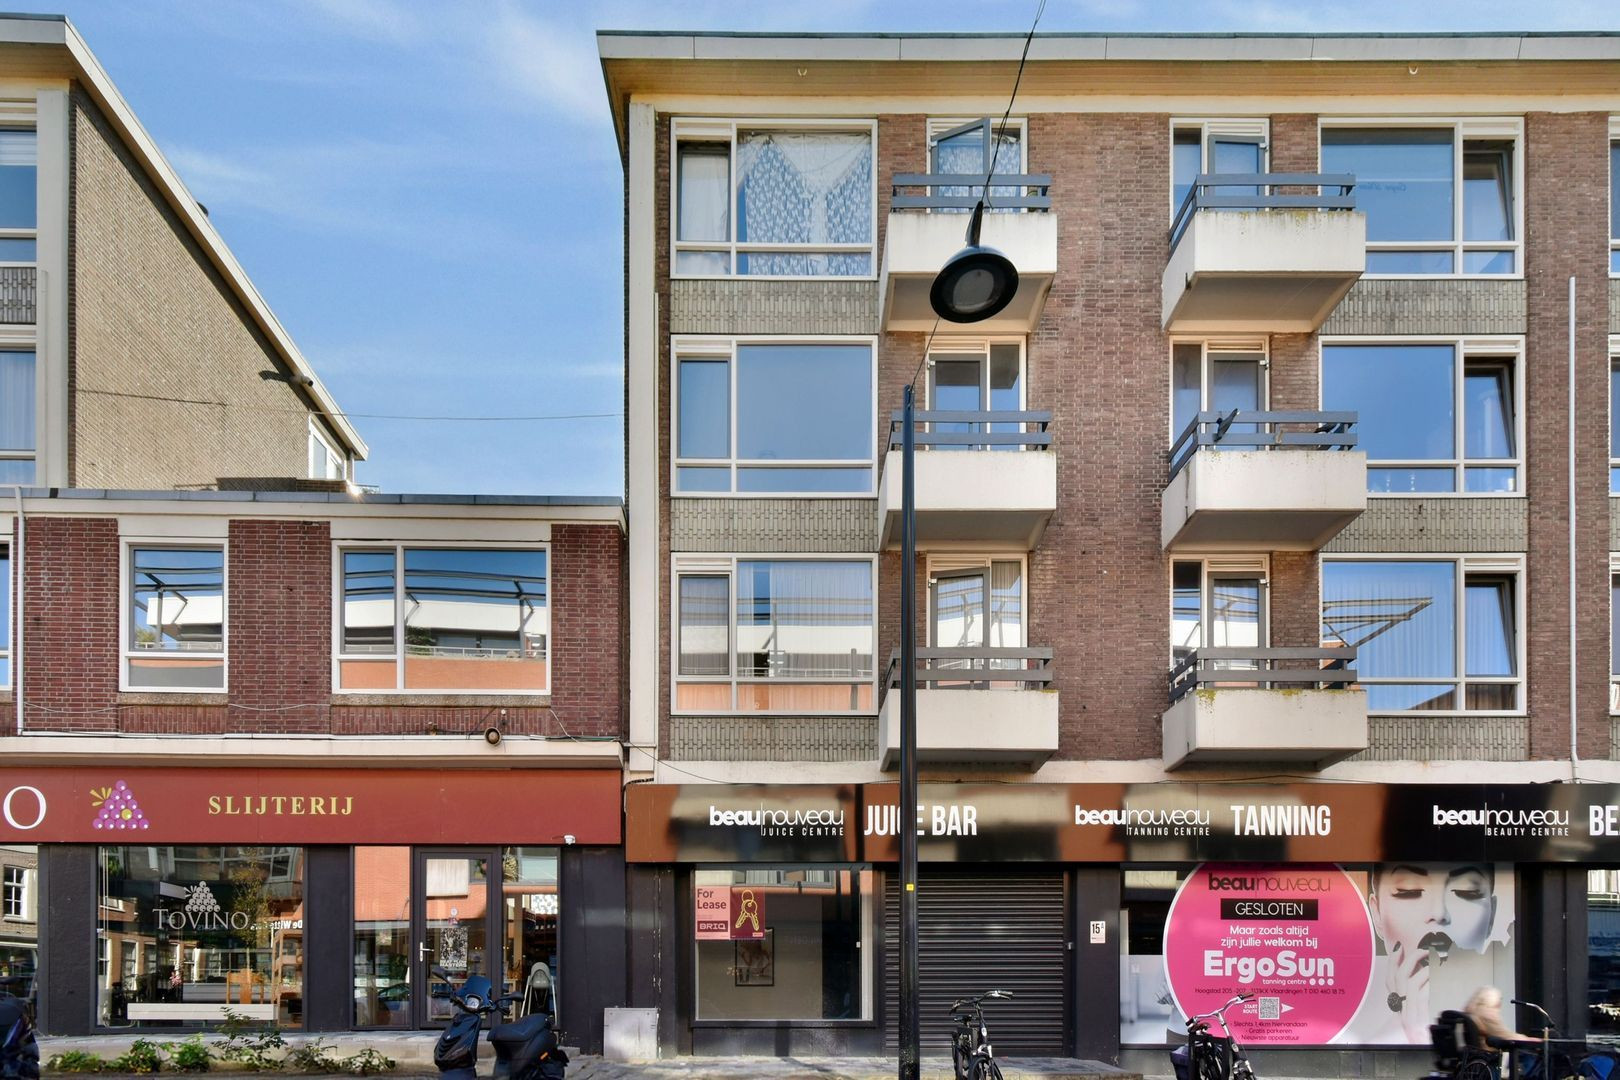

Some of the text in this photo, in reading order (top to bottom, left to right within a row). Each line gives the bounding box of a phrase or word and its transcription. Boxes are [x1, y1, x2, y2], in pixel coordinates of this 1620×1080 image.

[3, 785, 47, 830] O
[208, 795, 355, 816] SLIJTERIJ
[863, 804, 978, 836] JUIE BAR
[1229, 804, 1331, 836] TANNING
[763, 827, 844, 837] JUICE CENTRE
[1128, 827, 1210, 836] TANNING CENTRE
[1487, 827, 1569, 837] BEAUTY CENTRE
[697, 888, 714, 898] For
[697, 899, 727, 910] Lease
[1235, 902, 1304, 916] GESLOTEN
[699, 922, 727, 931] BRIQ
[1229, 925, 1309, 937] Maar zoals altijd
[1220, 938, 1318, 949] zijn jullie welkom bij
[1203, 950, 1334, 984] ErgoSun
[1262, 978, 1287, 986] tanning
